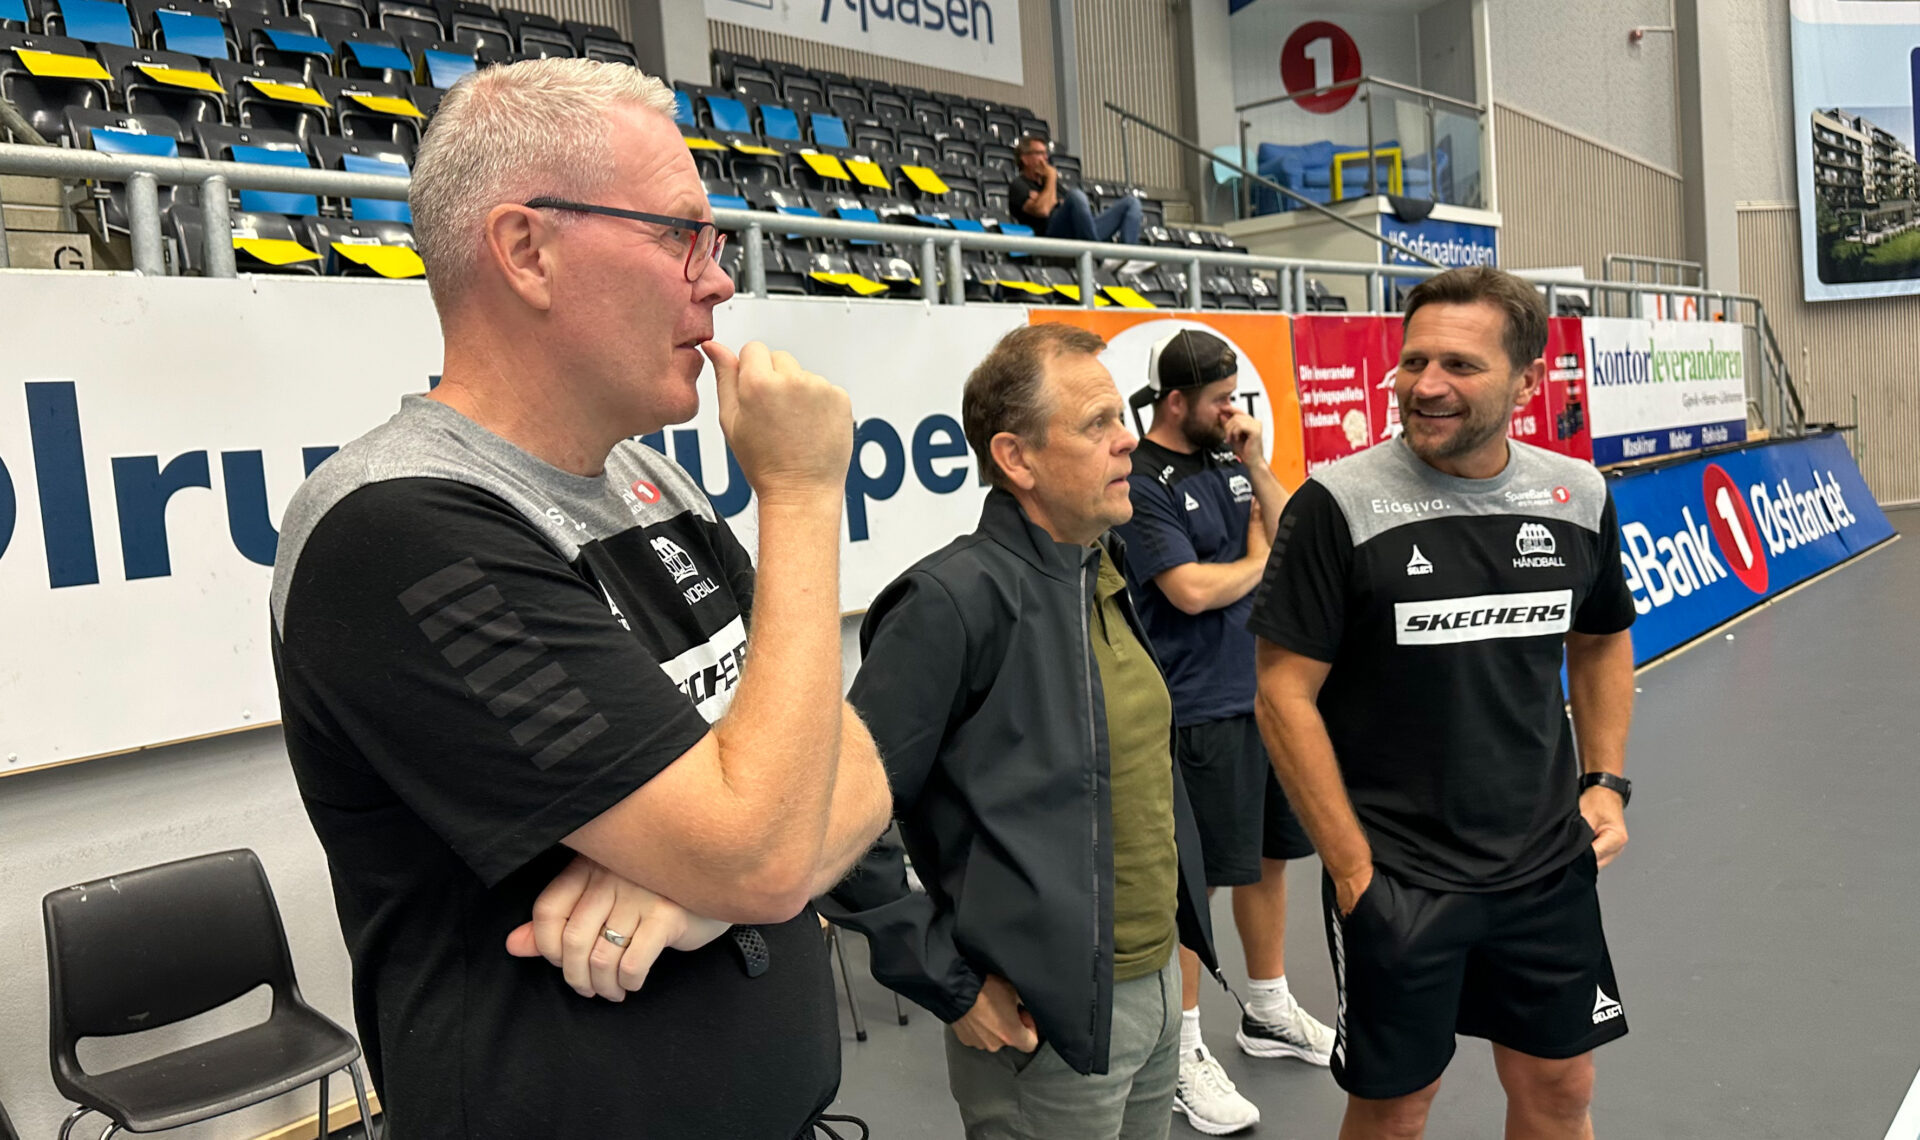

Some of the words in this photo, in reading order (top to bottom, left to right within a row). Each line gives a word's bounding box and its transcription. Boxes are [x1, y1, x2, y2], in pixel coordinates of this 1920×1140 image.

[1304, 37, 1334, 96] 1
[54, 246, 85, 270] G
[1715, 486, 1754, 570] 1
[1750, 470, 1856, 557] Østlandet
[1406, 565, 1434, 576] SELECT
[1512, 556, 1566, 568] HÅNDBALL
[1404, 603, 1568, 632] SKECHERS
[1592, 1004, 1623, 1024] SELECT
